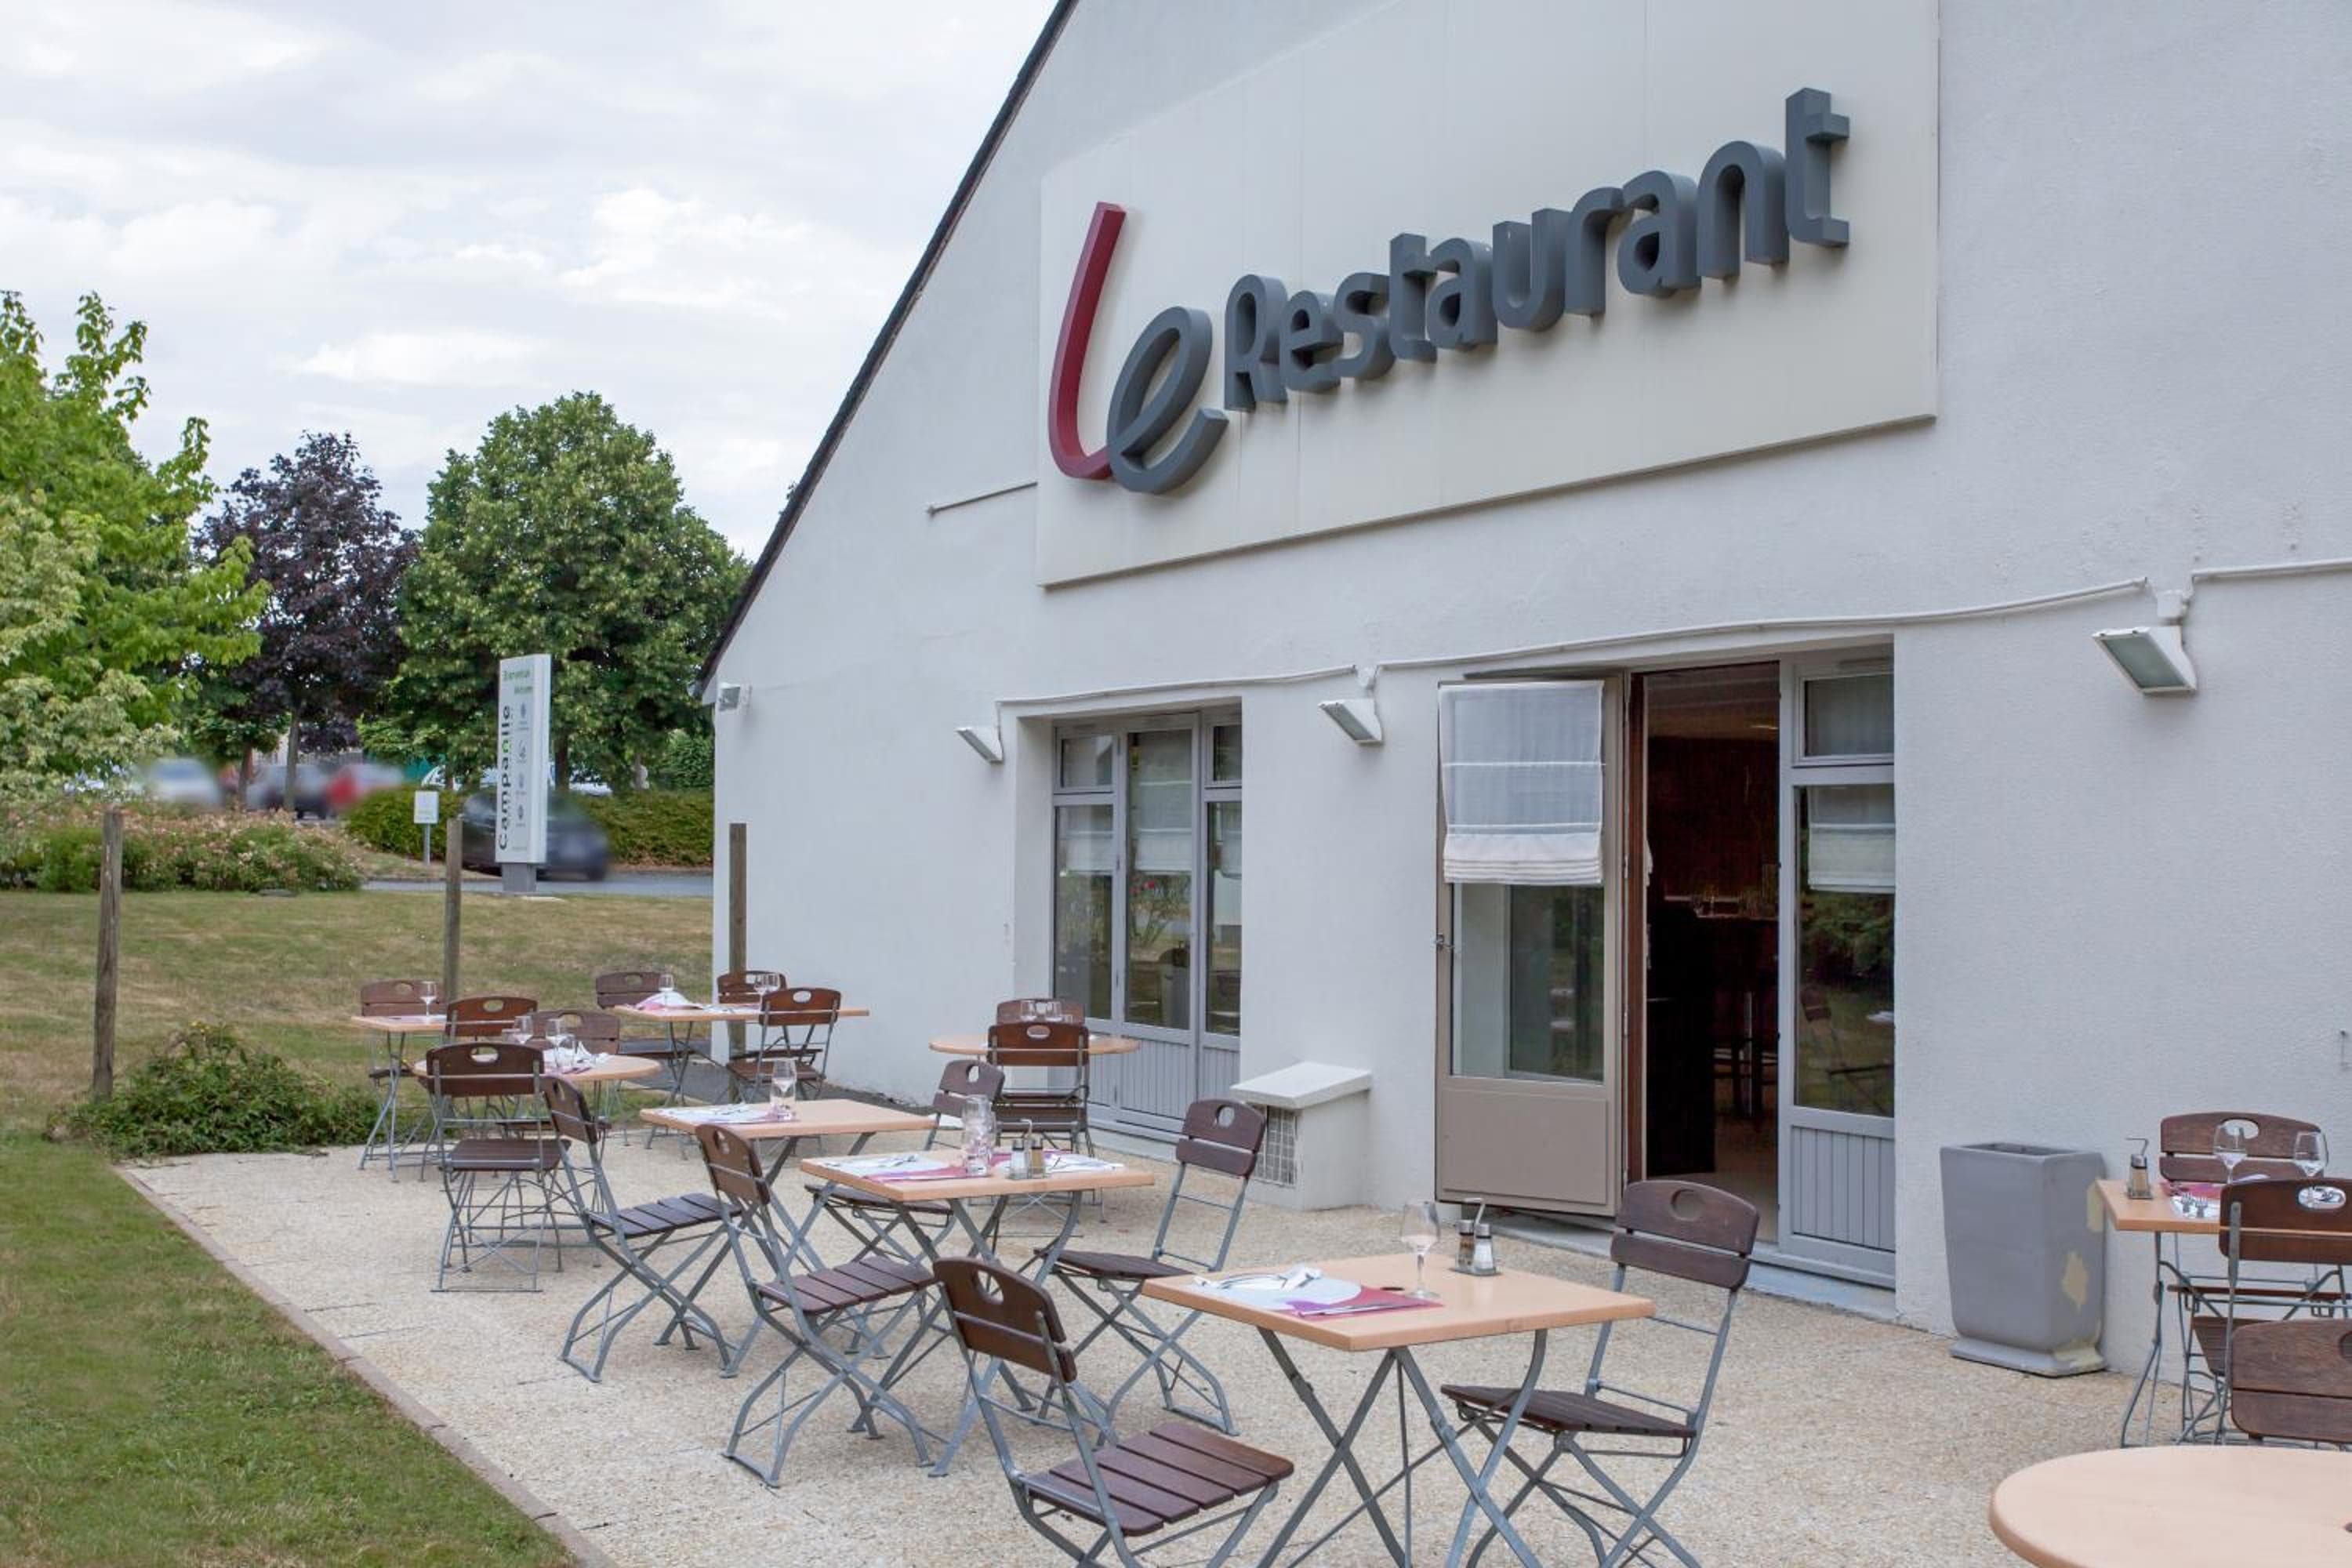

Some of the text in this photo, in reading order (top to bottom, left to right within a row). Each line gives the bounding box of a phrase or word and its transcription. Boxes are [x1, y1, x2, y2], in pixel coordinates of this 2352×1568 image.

[1047, 87, 1851, 495] Le Restaurant
[499, 705, 511, 850] Campanile
